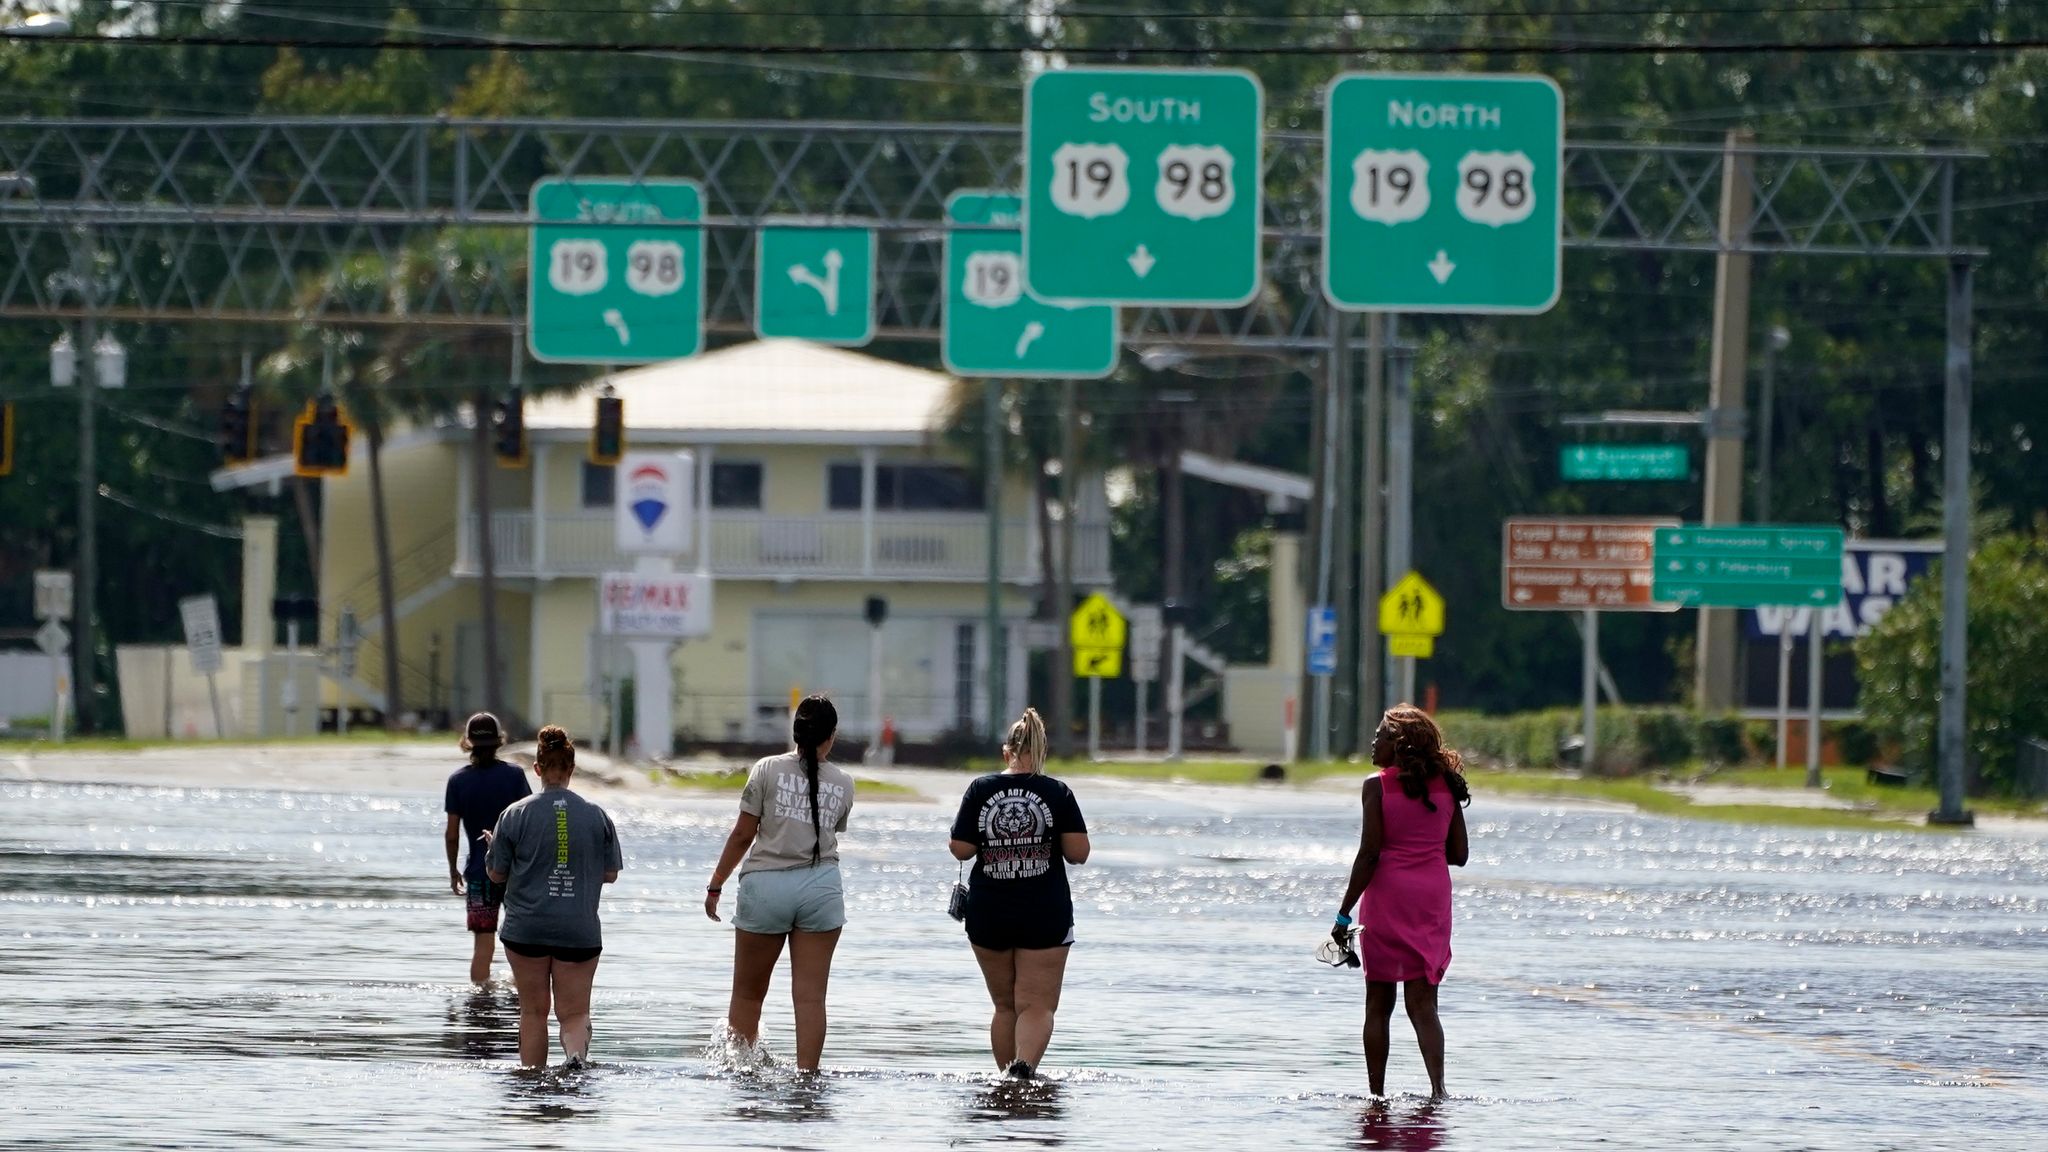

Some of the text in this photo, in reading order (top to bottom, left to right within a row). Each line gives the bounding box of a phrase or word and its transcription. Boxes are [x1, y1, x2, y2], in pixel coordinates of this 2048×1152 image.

[1089, 92, 1200, 123] SOUTH
[1387, 100, 1500, 128] NORTH
[1068, 160, 1226, 203] 19 98
[1368, 165, 1526, 209] 19 98
[561, 251, 677, 286] 19 98
[975, 263, 1011, 297] 19
[1842, 553, 1908, 595] AR
[1757, 597, 1893, 637] WAS
[777, 773, 844, 798] LIVNG
[556, 810, 568, 864] FINISHER
[982, 843, 1051, 865] WOLVES
[988, 839, 1002, 847] WILL
[1004, 838, 1012, 846] BE
[1034, 836, 1042, 844] BY
[1012, 860, 1020, 872] UP
[1022, 860, 1033, 871] THE
